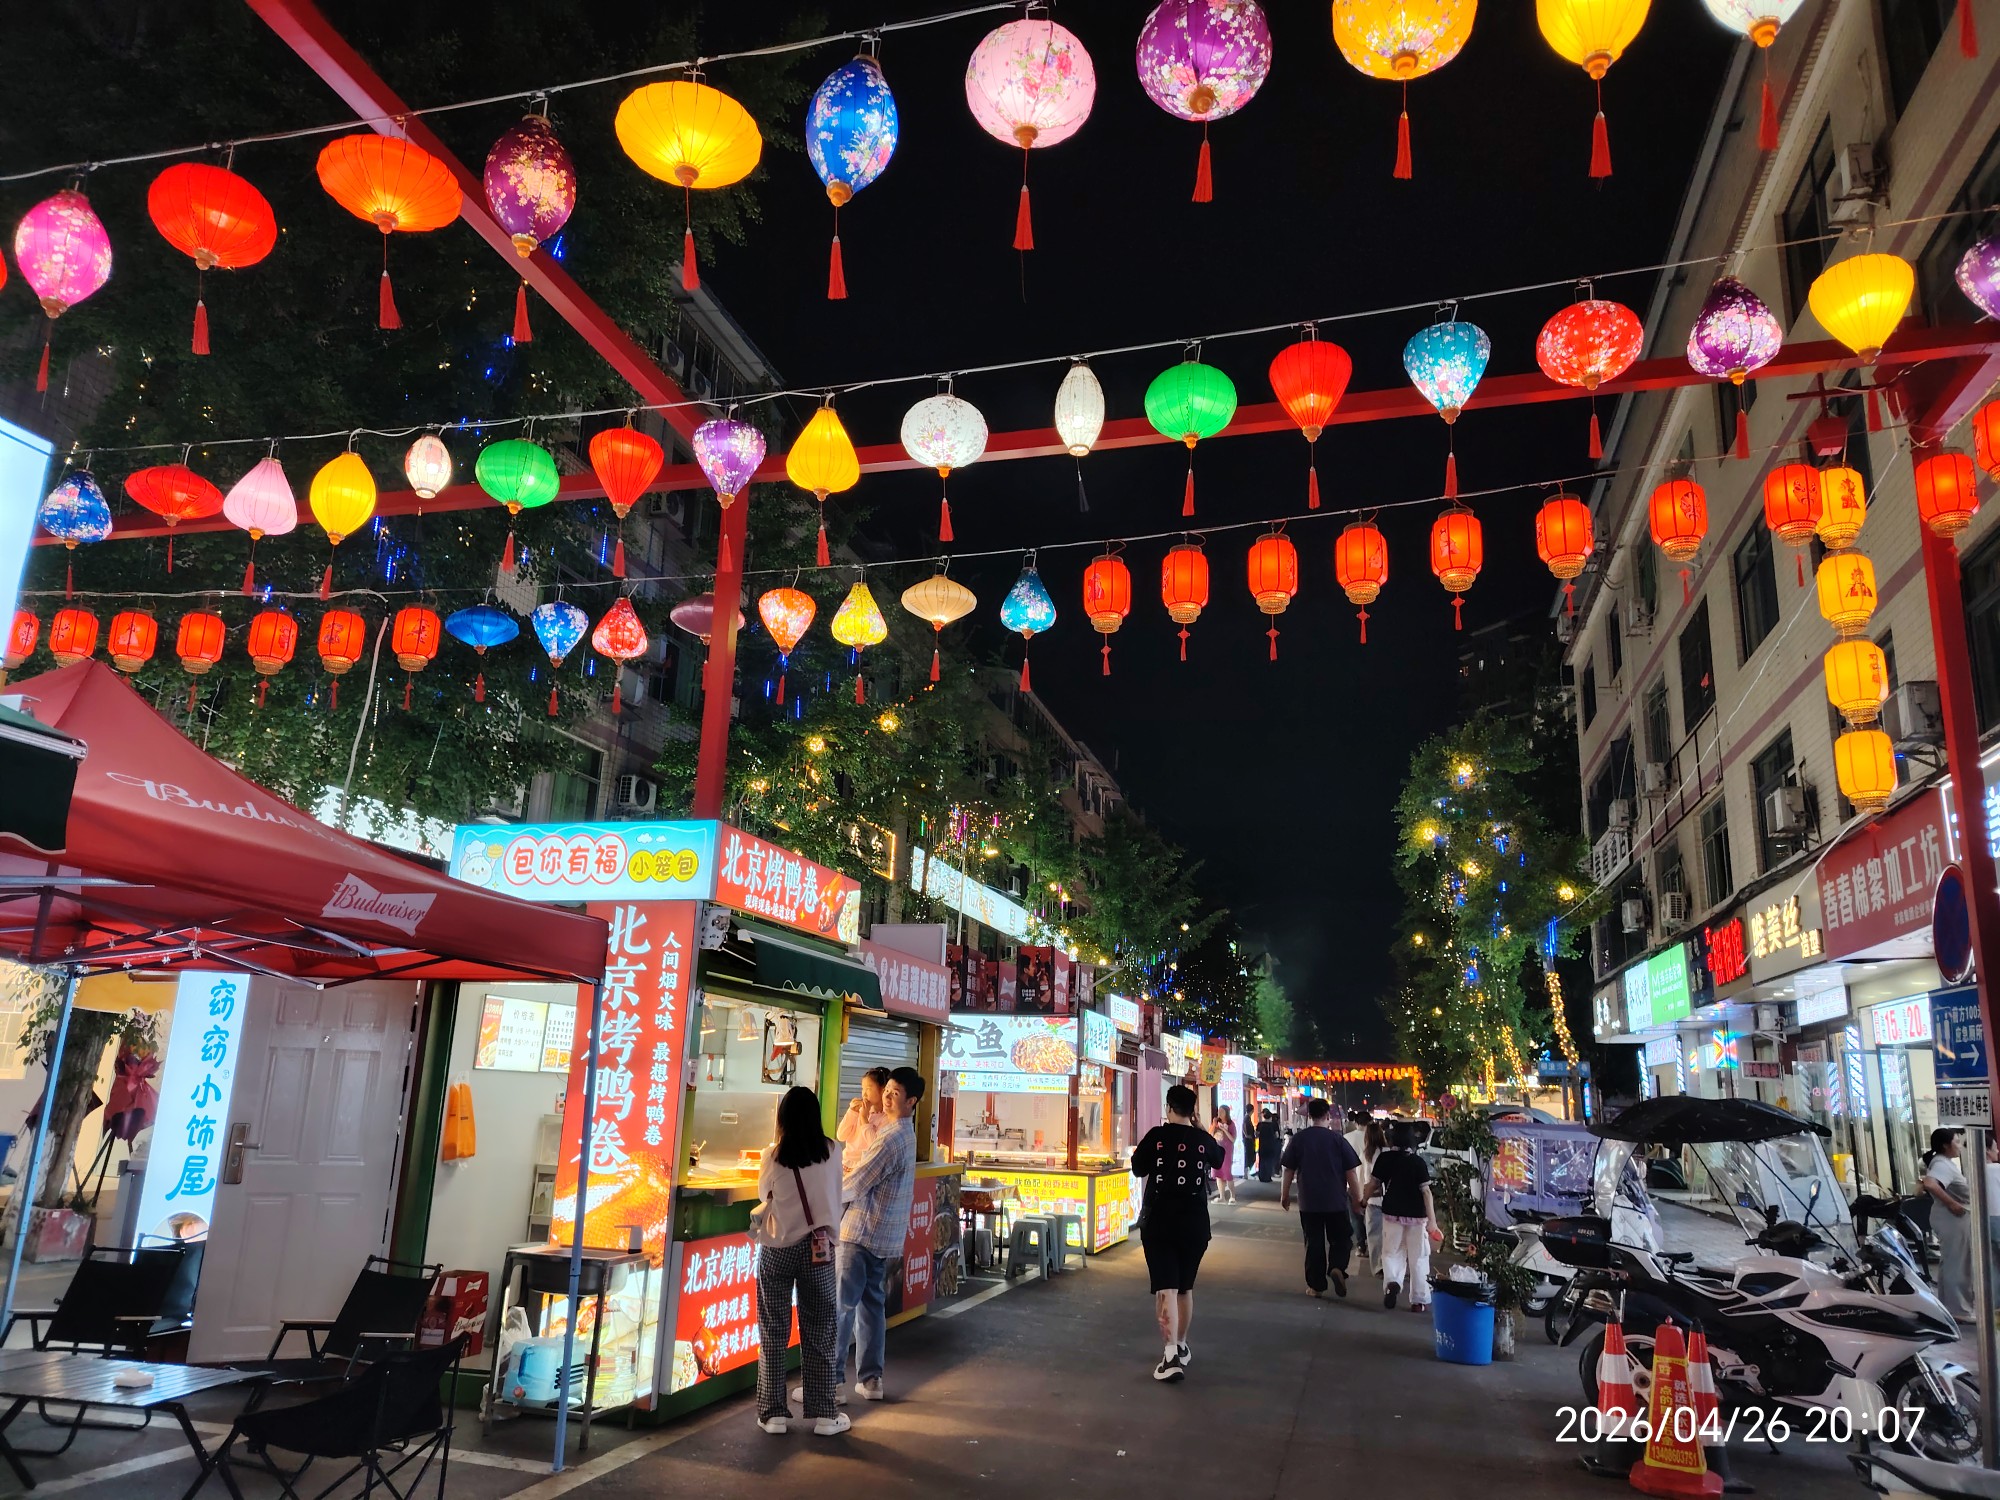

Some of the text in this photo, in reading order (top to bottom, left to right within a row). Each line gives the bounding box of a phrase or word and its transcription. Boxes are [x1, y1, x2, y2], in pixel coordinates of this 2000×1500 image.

[512, 836, 695, 879] 包你有福 小笼包
[721, 832, 820, 914] 北京烤鸭卷
[332, 881, 427, 923] Budweiser
[570, 905, 652, 1176] 北京烤鸭卷
[642, 931, 682, 1146] 人间烟火味 最想烤鸭卷
[165, 978, 238, 1202] 窈窈小饰屋
[704, 1293, 750, 1328] 现烤现卷
